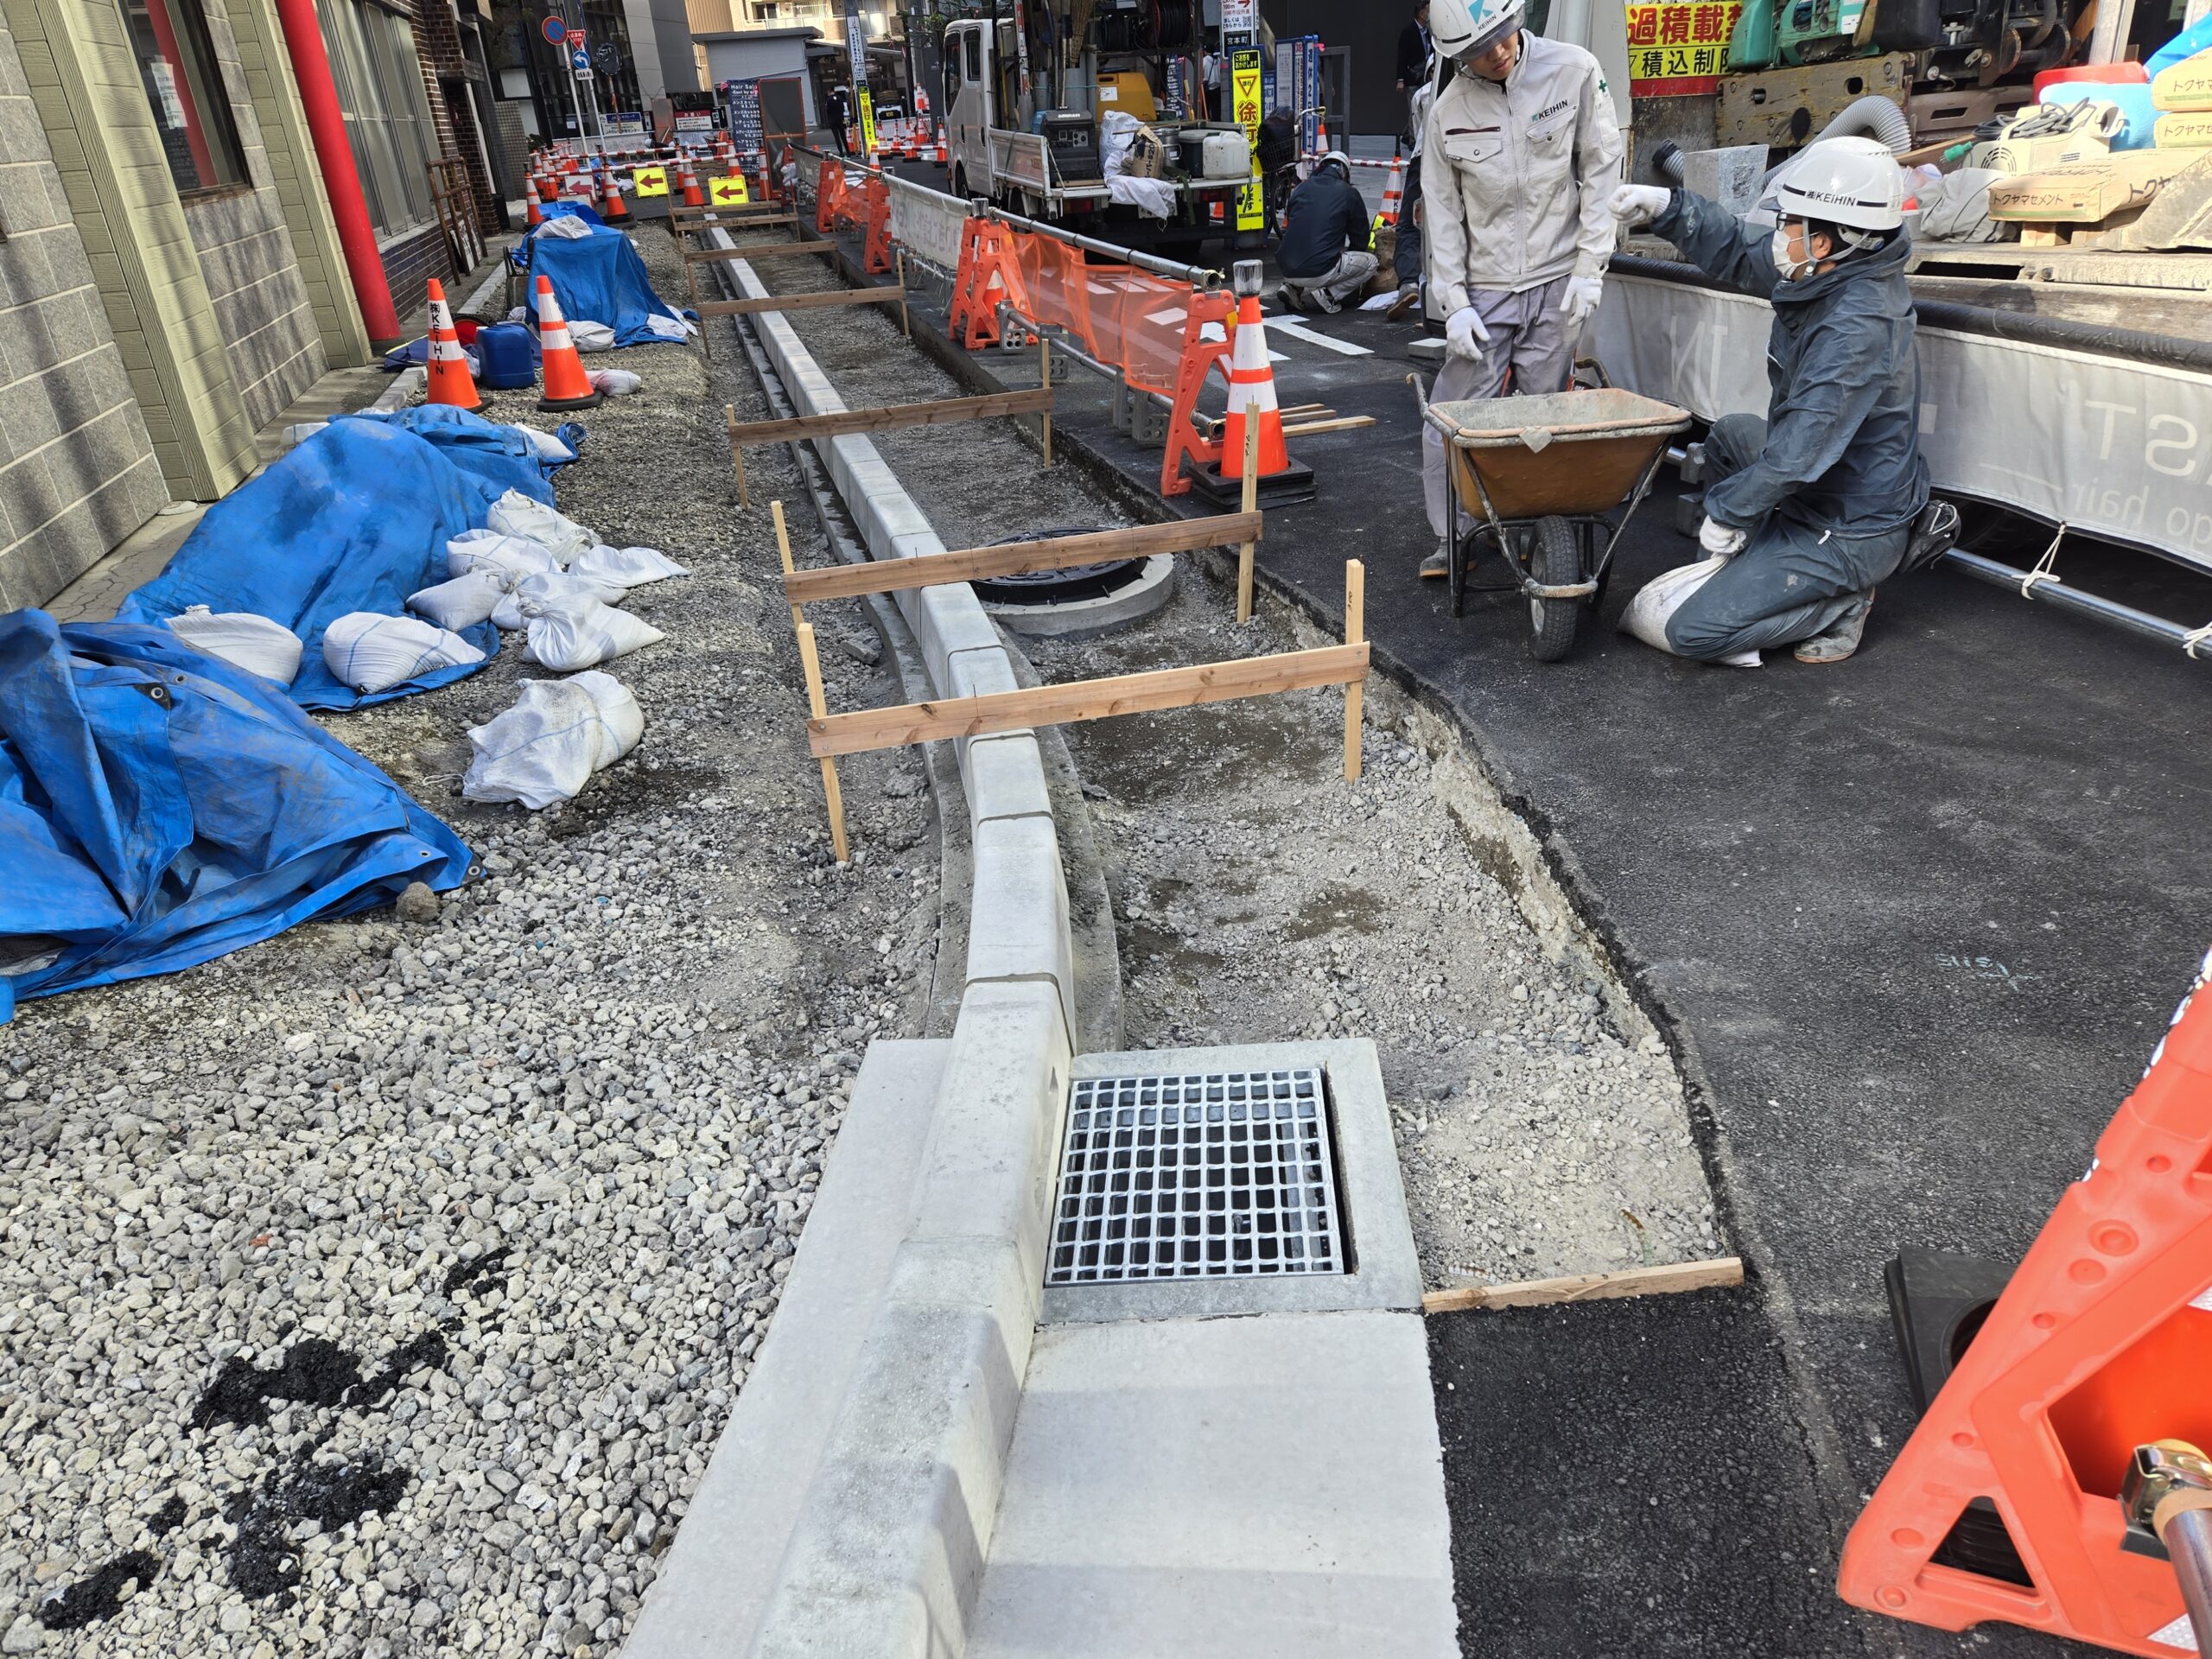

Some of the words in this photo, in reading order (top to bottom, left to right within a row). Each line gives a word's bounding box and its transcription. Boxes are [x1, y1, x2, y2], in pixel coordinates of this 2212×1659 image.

[1478, 15, 1497, 31] KEIHIN
[1538, 99, 1568, 120] KEIHIN
[1237, 100, 1258, 143] 徐行
[2128, 175, 2173, 203] トクヤ
[1993, 193, 2063, 207] トクヤマセメント
